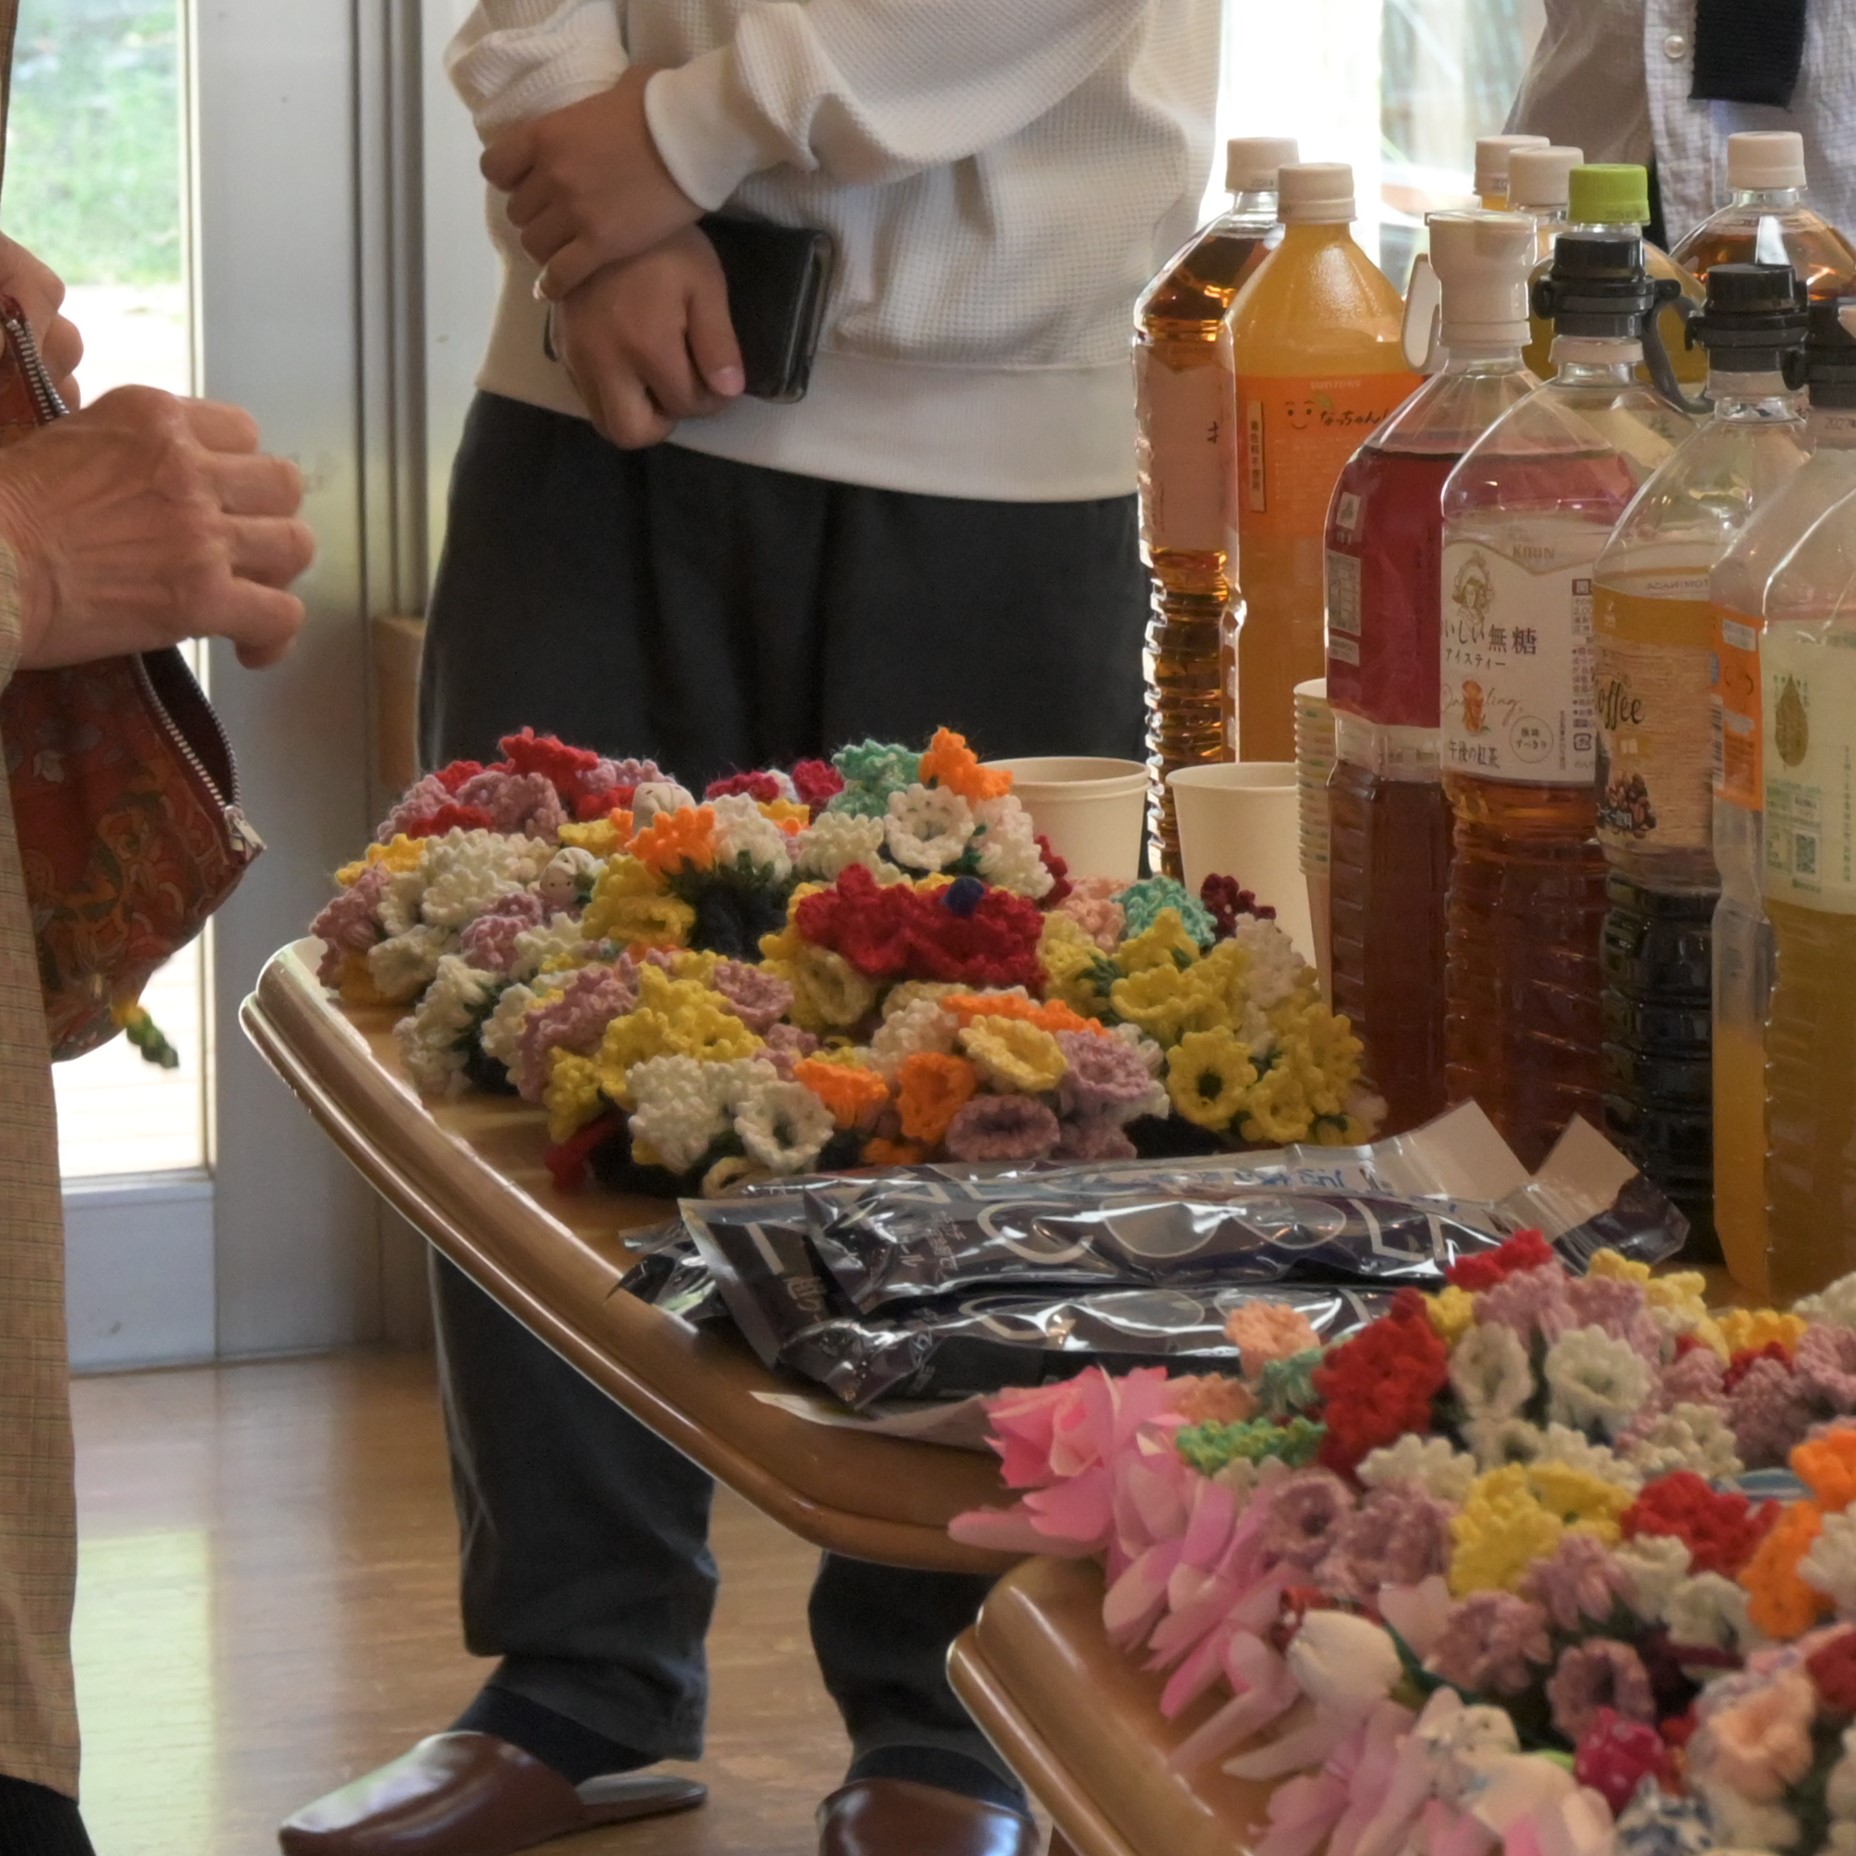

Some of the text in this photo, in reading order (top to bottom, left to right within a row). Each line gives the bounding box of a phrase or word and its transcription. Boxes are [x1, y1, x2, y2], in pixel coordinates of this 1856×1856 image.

[1512, 546, 1555, 559] KIRIN
[1594, 678, 1644, 731] offee
[1448, 739, 1502, 771] 午後の紅茶
